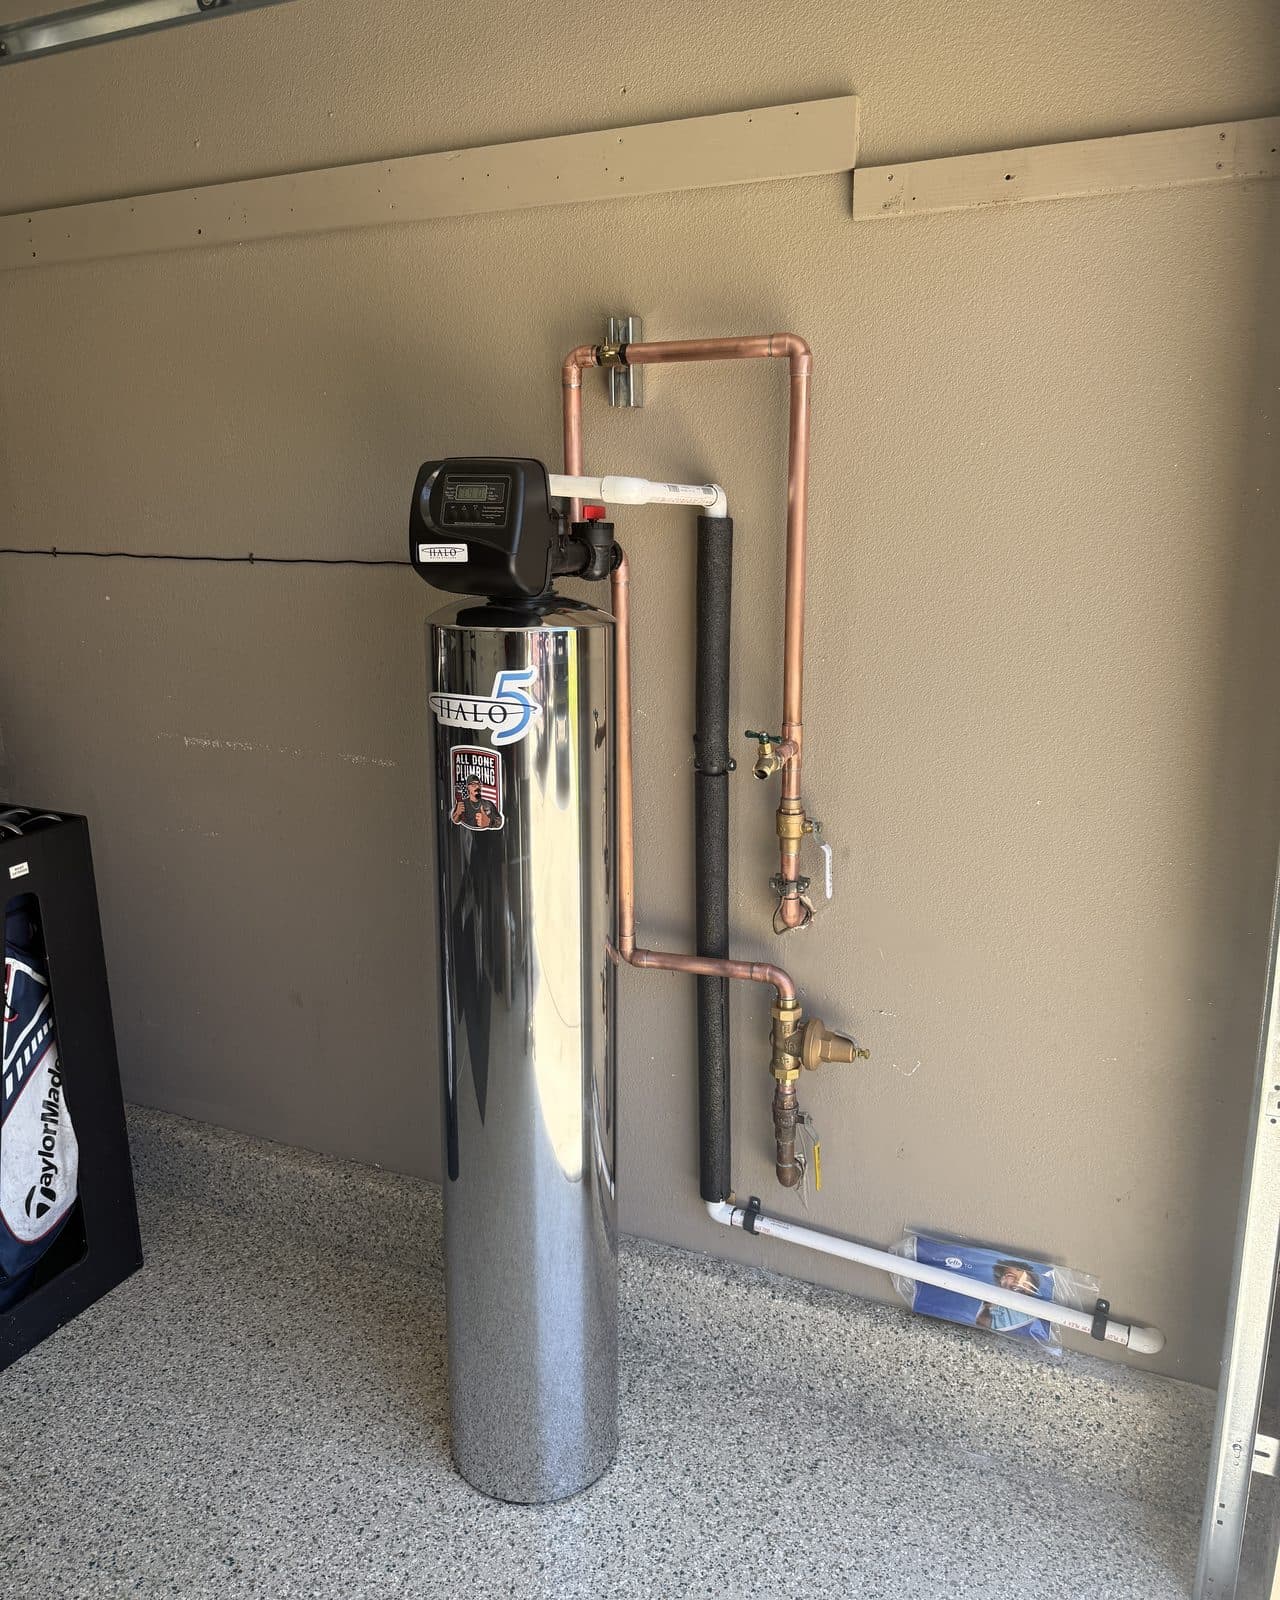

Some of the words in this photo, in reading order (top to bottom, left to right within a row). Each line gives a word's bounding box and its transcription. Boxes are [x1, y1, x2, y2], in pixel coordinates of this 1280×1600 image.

[430, 549, 456, 557] HALO
[440, 699, 507, 724] HALO
[496, 670, 534, 739] 5
[456, 755, 469, 764] ALL
[472, 755, 495, 769] DONE
[455, 764, 496, 786] PLUMBING
